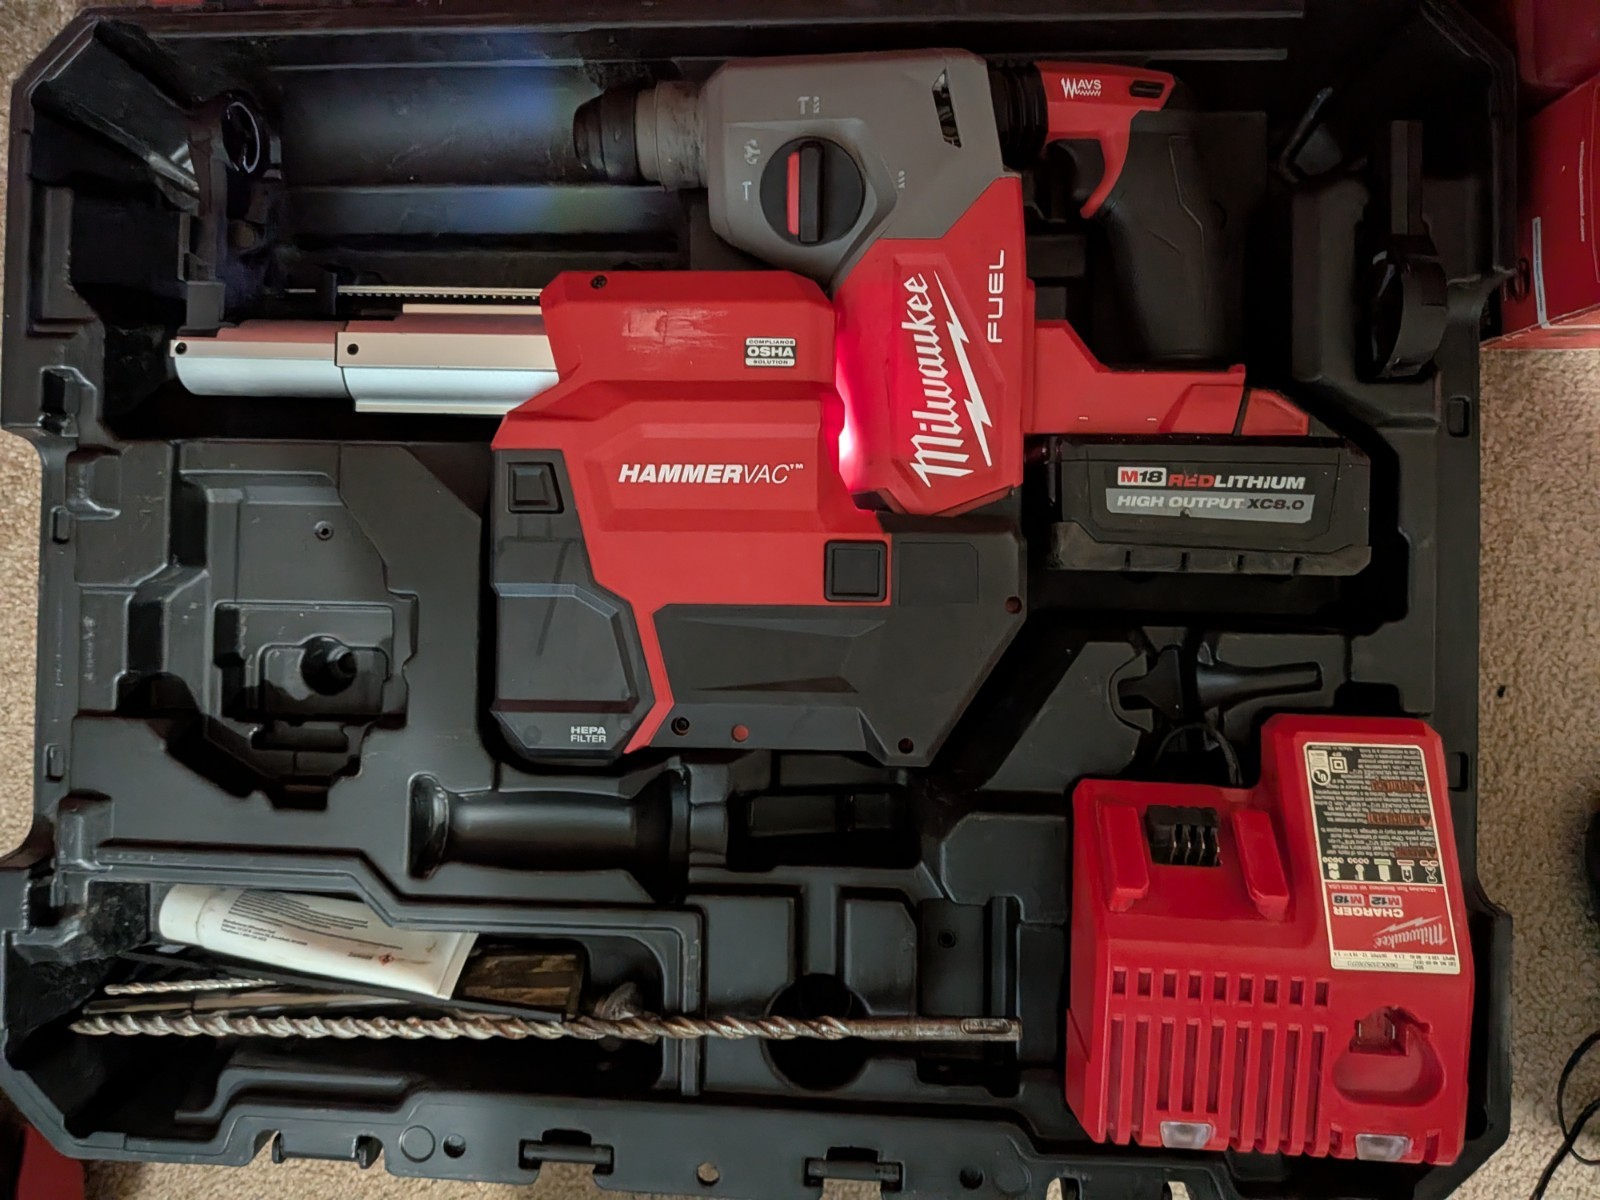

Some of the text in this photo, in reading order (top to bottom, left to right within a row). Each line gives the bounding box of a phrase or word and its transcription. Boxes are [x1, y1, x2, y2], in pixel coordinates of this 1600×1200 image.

[987, 250, 1004, 343] FUEL
[747, 346, 794, 357] OSHA
[902, 272, 974, 488] Milwaukee
[1120, 470, 1306, 490] M18 REDLITHIUM
[1117, 495, 1304, 510] HIGH OUTPUT XC8.0
[570, 726, 606, 734] HEPA
[570, 734, 606, 743] FILTER
[1334, 894, 1400, 906] M12 M18
[1334, 906, 1404, 918] CHARGER
[1375, 922, 1448, 949] Milwaukee
